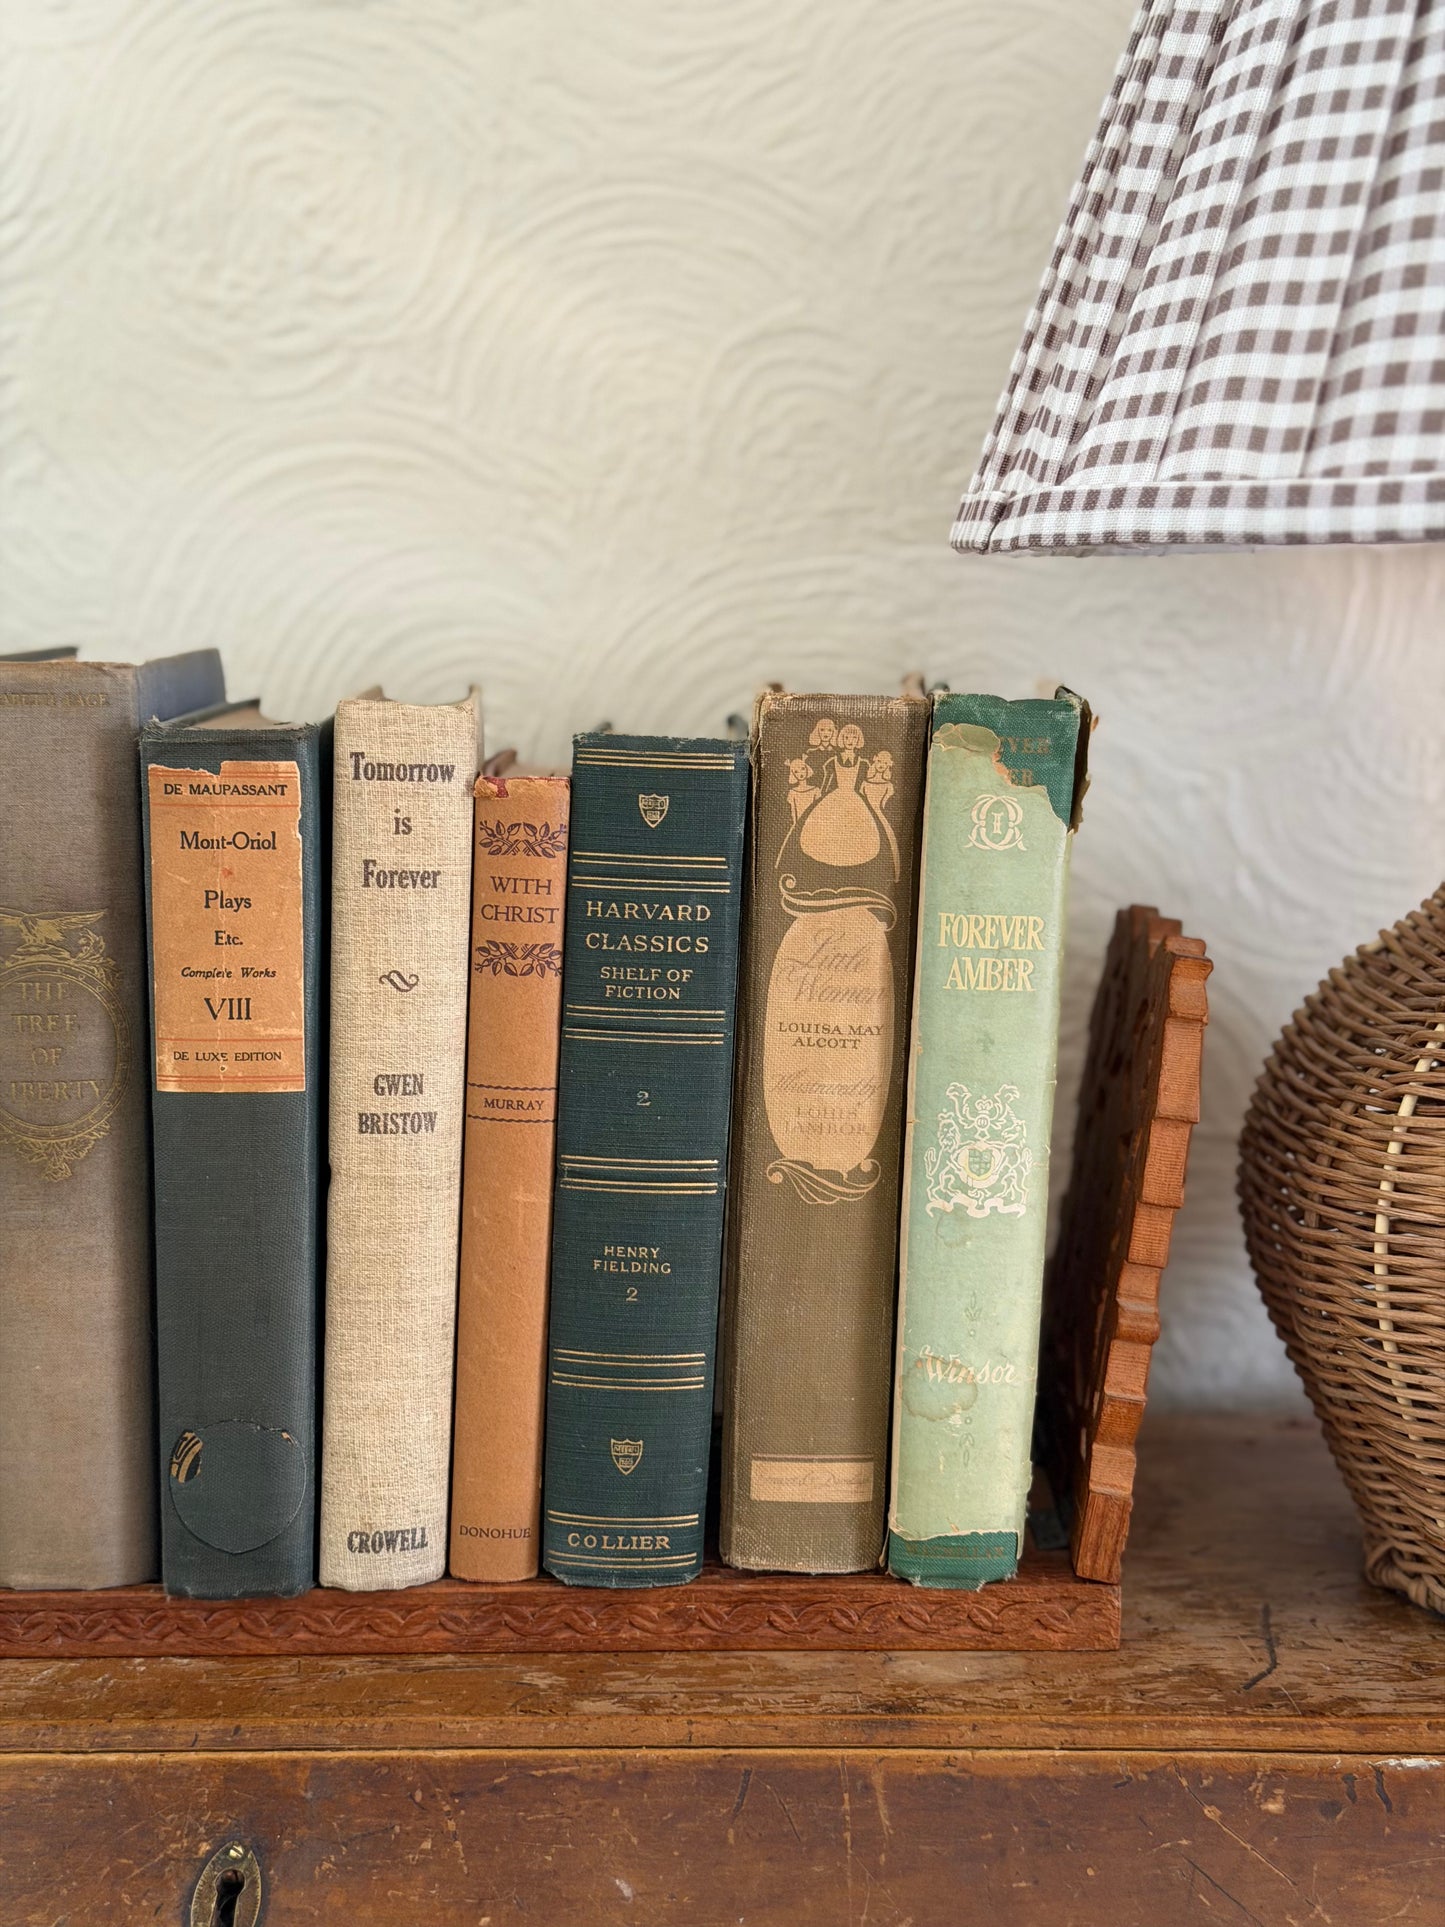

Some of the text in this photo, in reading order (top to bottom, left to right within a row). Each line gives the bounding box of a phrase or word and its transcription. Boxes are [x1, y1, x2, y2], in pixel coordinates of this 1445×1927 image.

[350, 751, 456, 783] Tomorrow
[163, 783, 288, 796] DE MAUPASSANT
[393, 807, 413, 835] is
[180, 830, 277, 850] Mont-Oriol
[362, 859, 441, 889] Forever
[490, 875, 552, 895] WITH
[204, 889, 252, 913] Plays
[586, 900, 711, 922] HARVARD
[480, 903, 560, 924] CHRIST
[214, 930, 244, 946] Etc.
[937, 912, 1046, 951] FOREVER
[585, 932, 710, 954] CLASSICS
[180, 966, 277, 979] Complete Works
[600, 965, 694, 983] SHELF OF
[942, 956, 1038, 992] AMBER
[604, 984, 681, 1000] FICTION
[203, 997, 252, 1021] VIII
[778, 1021, 885, 1036] LOUISA MAY
[791, 1036, 862, 1050] ALCOTT
[31, 1046, 63, 1067] OF
[173, 1051, 282, 1062] DE LUXE EDITION
[9, 1079, 104, 1101] IBERTY
[373, 1073, 425, 1097] GWEN
[484, 1097, 545, 1111] MURRAY
[636, 1090, 652, 1106] 2
[357, 1111, 438, 1135] BRISTOW
[603, 1245, 661, 1259] HENRY
[593, 1258, 672, 1274] FIELDING
[625, 1287, 639, 1302] 2
[919, 1344, 1016, 1385] Winsor
[347, 1527, 429, 1555] CROWELL
[459, 1524, 531, 1539] DONOHUE
[566, 1531, 672, 1550] COLLIER
